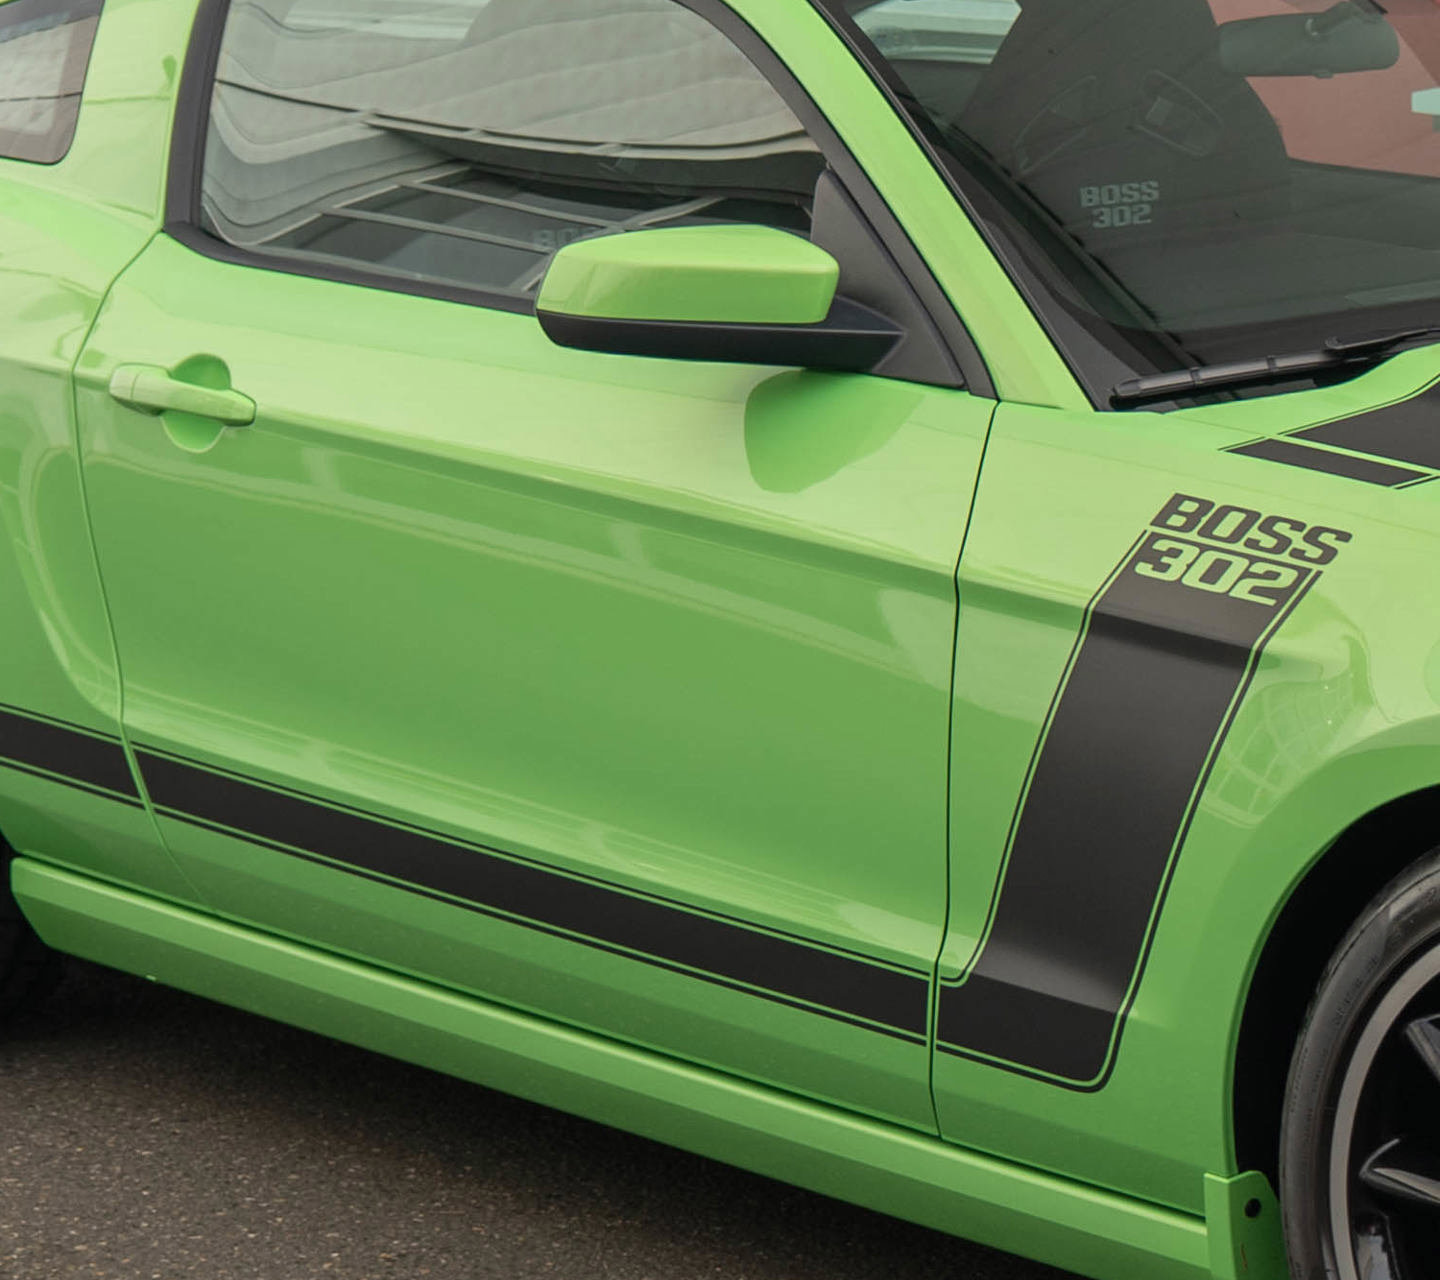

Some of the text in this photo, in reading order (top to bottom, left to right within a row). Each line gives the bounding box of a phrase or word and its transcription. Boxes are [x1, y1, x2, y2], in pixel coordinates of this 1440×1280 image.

[1080, 181, 1160, 208] BOSS
[1092, 204, 1152, 228] 302
[1149, 492, 1353, 566] BOSS
[1134, 538, 1299, 607] 302
